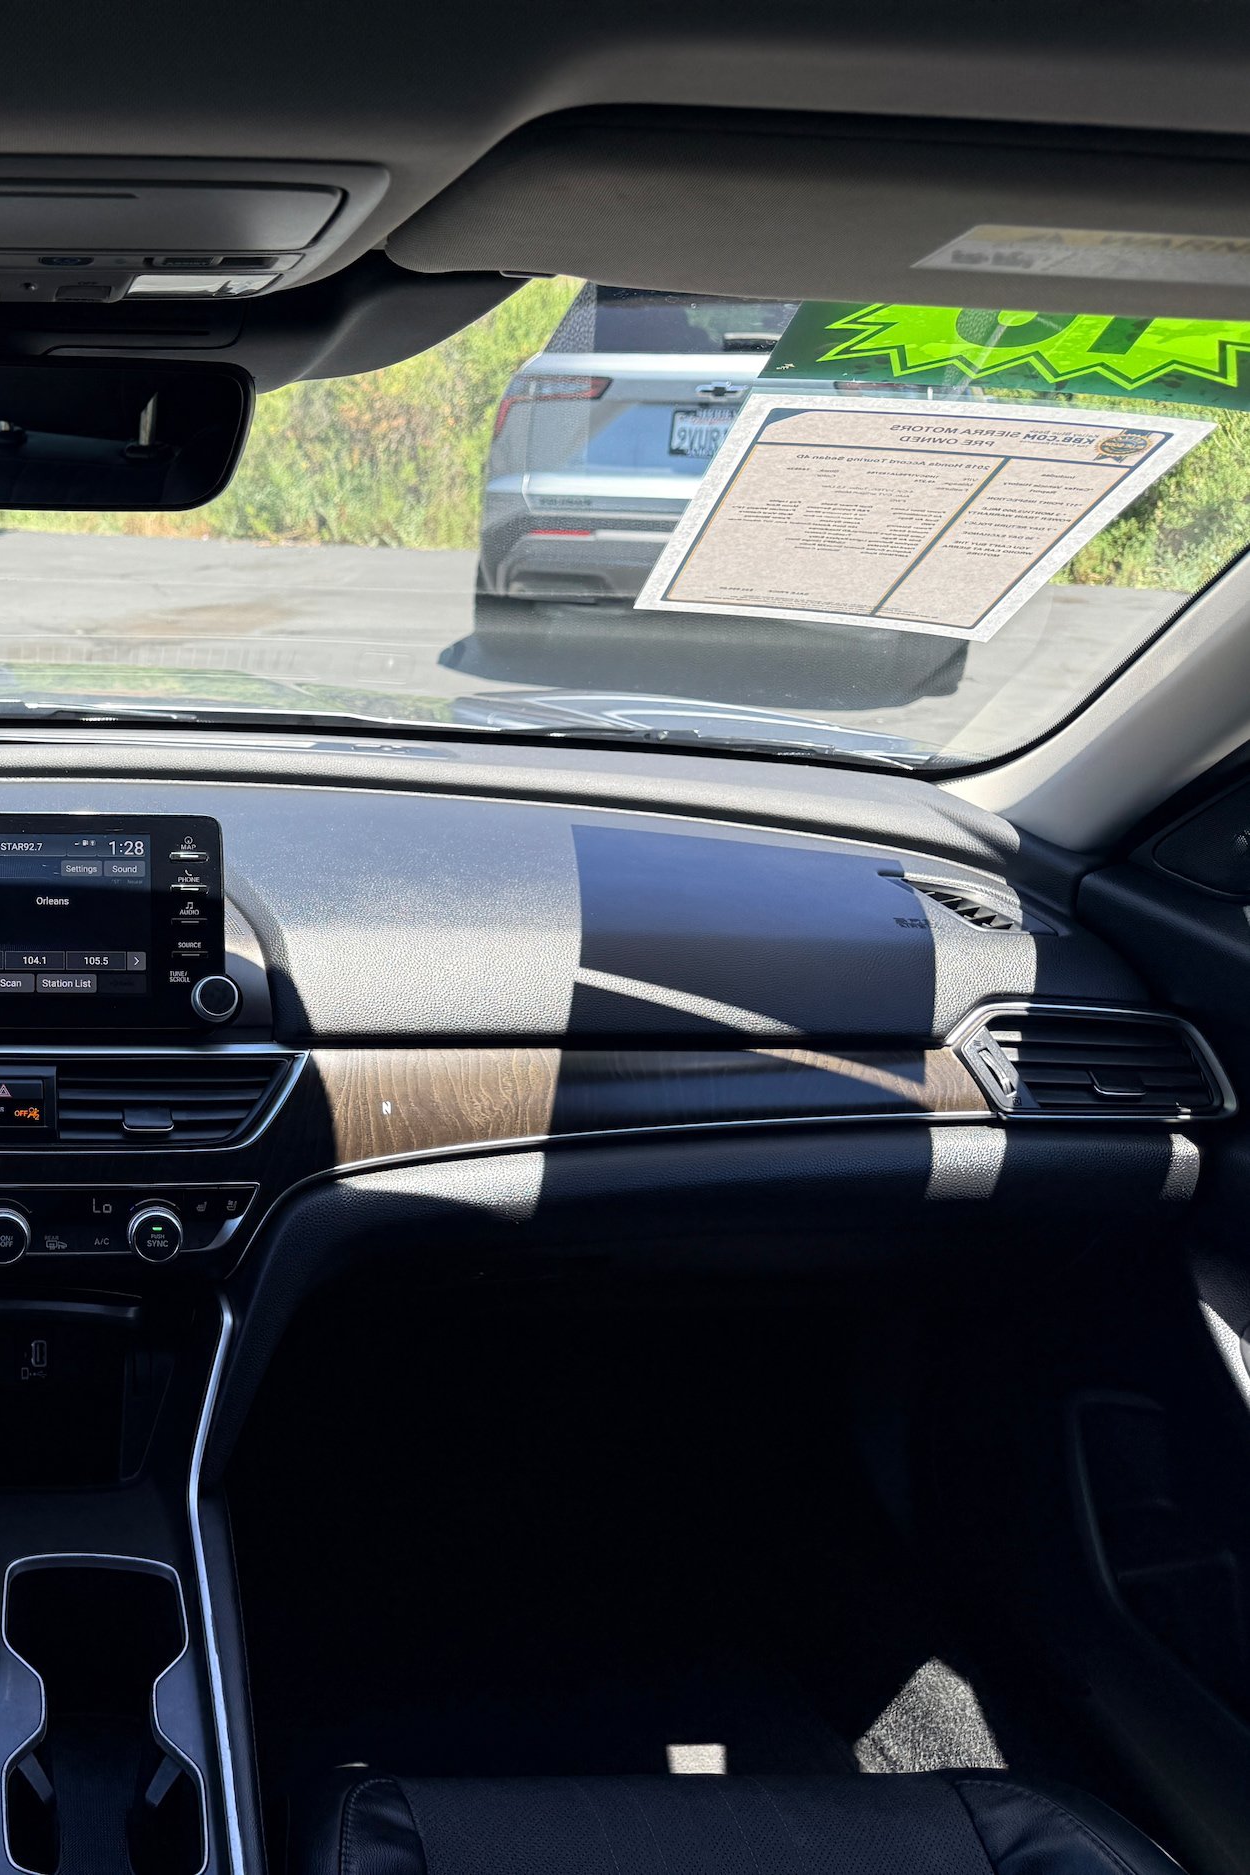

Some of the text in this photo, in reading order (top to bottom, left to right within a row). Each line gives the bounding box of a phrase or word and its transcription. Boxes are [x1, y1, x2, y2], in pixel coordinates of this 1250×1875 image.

[1, 842, 42, 851] STAR92.7
[108, 841, 144, 856] 1:28
[65, 864, 97, 874] Settings
[112, 864, 138, 874] Sound
[36, 896, 70, 906] Orleans
[22, 956, 47, 965] 104.1
[83, 956, 109, 966] 105.5
[0, 979, 22, 988] Scan
[41, 979, 91, 988] Station List
[93, 1198, 112, 1214] Lo
[94, 1237, 110, 1246] A/C
[147, 1239, 169, 1248] SYNC
